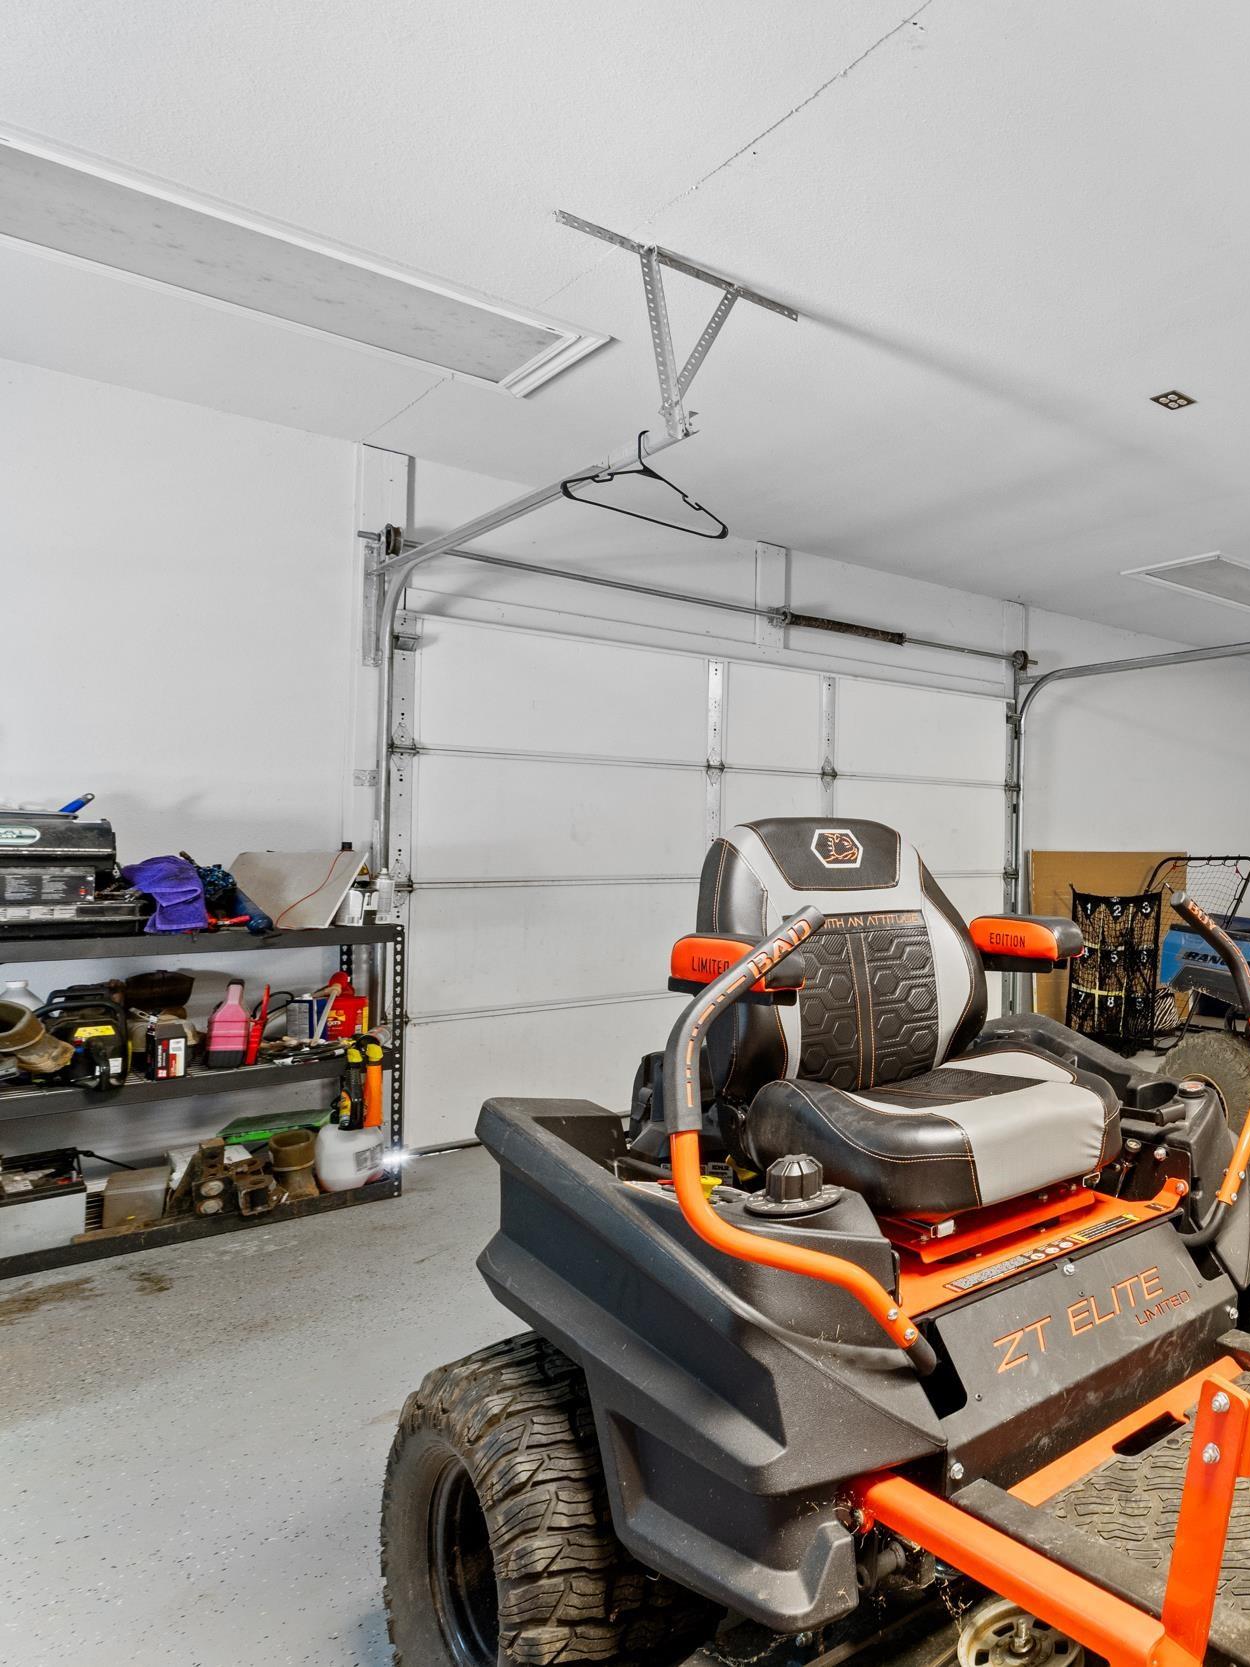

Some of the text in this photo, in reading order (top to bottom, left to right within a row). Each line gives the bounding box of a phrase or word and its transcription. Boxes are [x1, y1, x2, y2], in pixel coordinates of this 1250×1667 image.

[1086, 902, 1151, 917] 1 2 3
[1187, 898, 1218, 931] BOY
[848, 916, 864, 928] AN
[867, 911, 919, 927] ATTITUDE
[746, 917, 813, 980] BAD
[989, 931, 1027, 948] EDITION
[691, 956, 731, 975] LIMITED
[1110, 952, 1119, 963] 5
[1078, 991, 1086, 1003] 7
[1107, 995, 1115, 1008] 8
[1135, 1289, 1192, 1327] LIMITED
[993, 1314, 1052, 1374] ZT
[1066, 1265, 1165, 1337] ELITE
